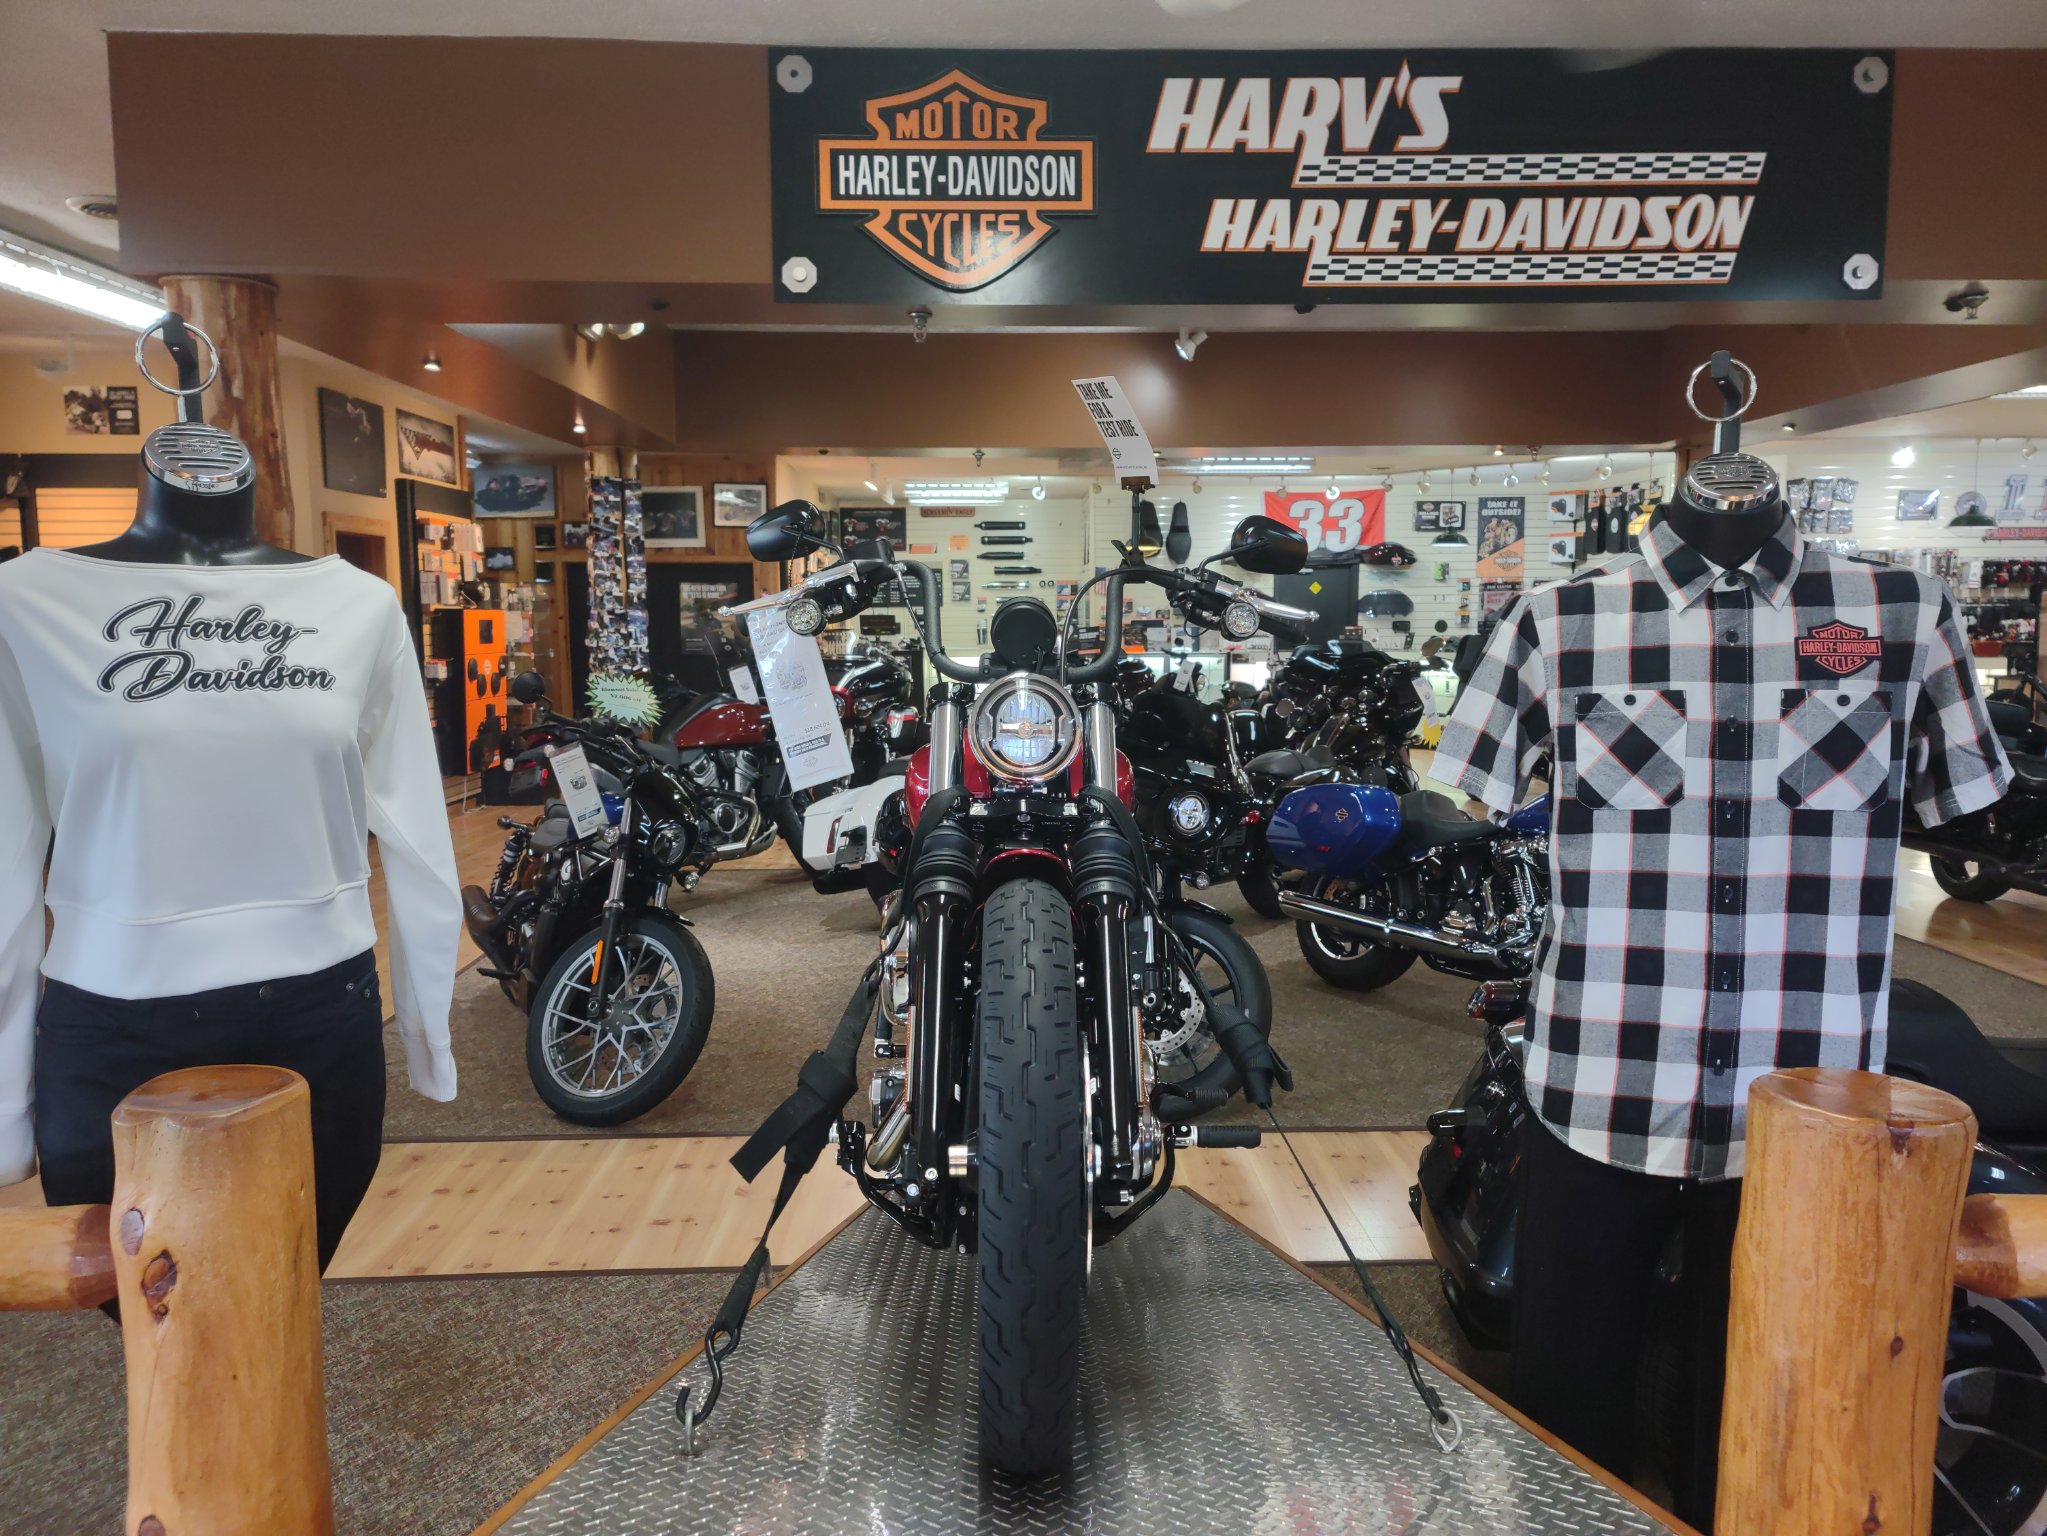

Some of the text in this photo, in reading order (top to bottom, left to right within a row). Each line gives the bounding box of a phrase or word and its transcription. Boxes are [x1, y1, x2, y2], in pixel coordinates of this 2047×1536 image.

[895, 90, 1019, 139] MOTOR
[1146, 58, 1463, 153] HARV'S
[838, 154, 1076, 197] HARLEY-DAVIDSON
[898, 212, 1020, 268] CYCLES
[1200, 193, 1755, 253] HARLEY-DAVIDSON
[1076, 382, 1113, 400] TAKE ME
[1087, 401, 1114, 419] FOR A
[1097, 419, 1139, 437] TEST RIDE
[1288, 498, 1365, 553] 33
[1481, 508, 1522, 516] OUTSIDE!
[103, 594, 318, 655] Harley-
[1819, 627, 1859, 640] MOTOR
[1802, 642, 1878, 653] HARLEY-DAVIDSON
[1821, 656, 1861, 671] CYCLES
[97, 649, 336, 703] Davidson
